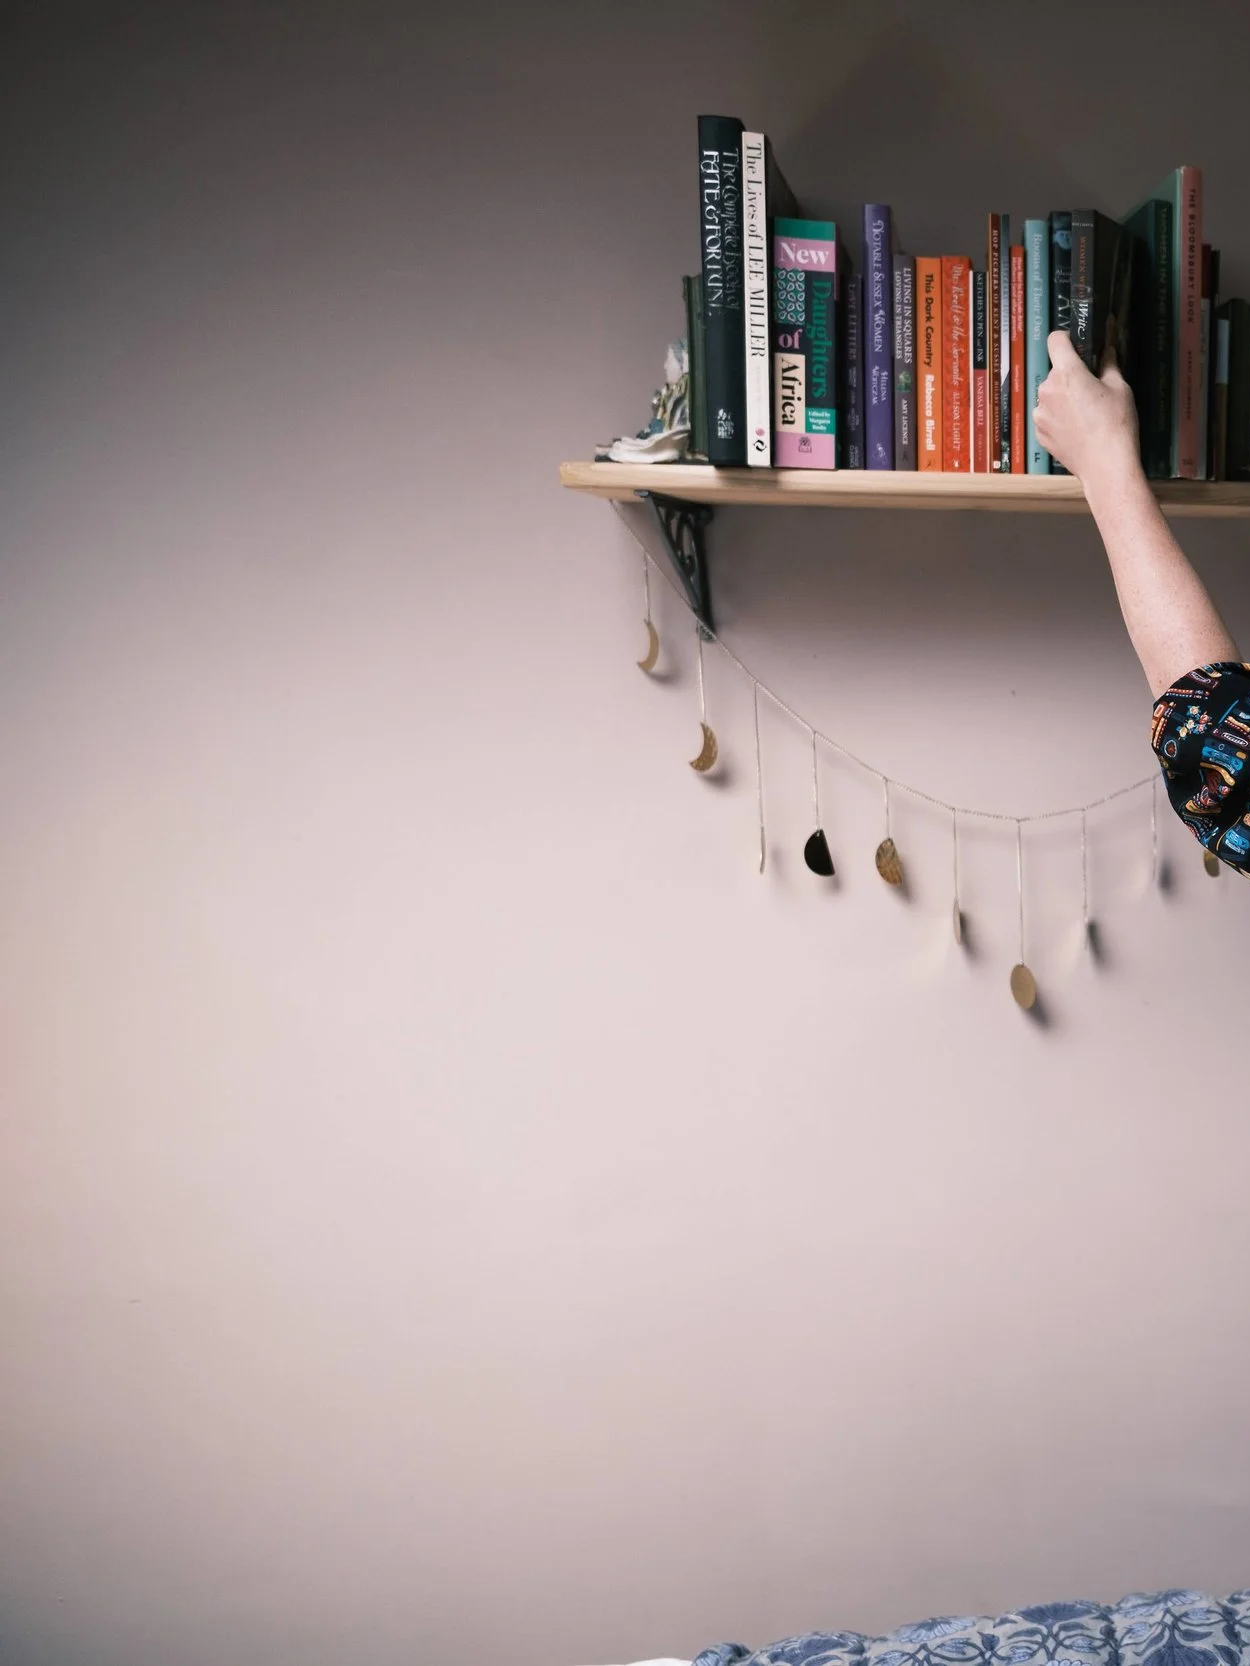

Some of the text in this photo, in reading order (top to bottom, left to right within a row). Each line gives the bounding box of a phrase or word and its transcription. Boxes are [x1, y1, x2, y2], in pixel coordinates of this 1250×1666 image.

[700, 150, 721, 204] FATE
[722, 147, 740, 184] The
[746, 143, 762, 174] The
[720, 185, 740, 249] Complete
[747, 180, 763, 221] Lives
[1188, 188, 1196, 209] THE
[748, 224, 764, 240] of
[748, 244, 764, 281] LEE
[780, 242, 829, 265] New
[1079, 236, 1087, 273] WOMEN
[1188, 214, 1196, 290] BLOOMSBURY
[872, 219, 885, 352] NOTABLE SUSSEX WOMEN
[976, 273, 984, 311] SKETCHES
[1033, 233, 1044, 341] Rooms of Their Own
[749, 288, 766, 357] MILLER
[895, 304, 902, 313] IN
[903, 267, 912, 364] LIVING IN SQUARES
[976, 312, 984, 321] IN
[1077, 303, 1089, 340] Write
[779, 329, 802, 350] of
[805, 281, 832, 398] Daughters
[976, 322, 984, 338] PEN
[924, 273, 936, 451] This Dark Country Rebecca Birrell
[976, 348, 984, 362] INK
[782, 357, 802, 425] Africa
[976, 375, 984, 408] VANESSA
[976, 409, 984, 426] BELL
[952, 423, 961, 451] LIGHT
